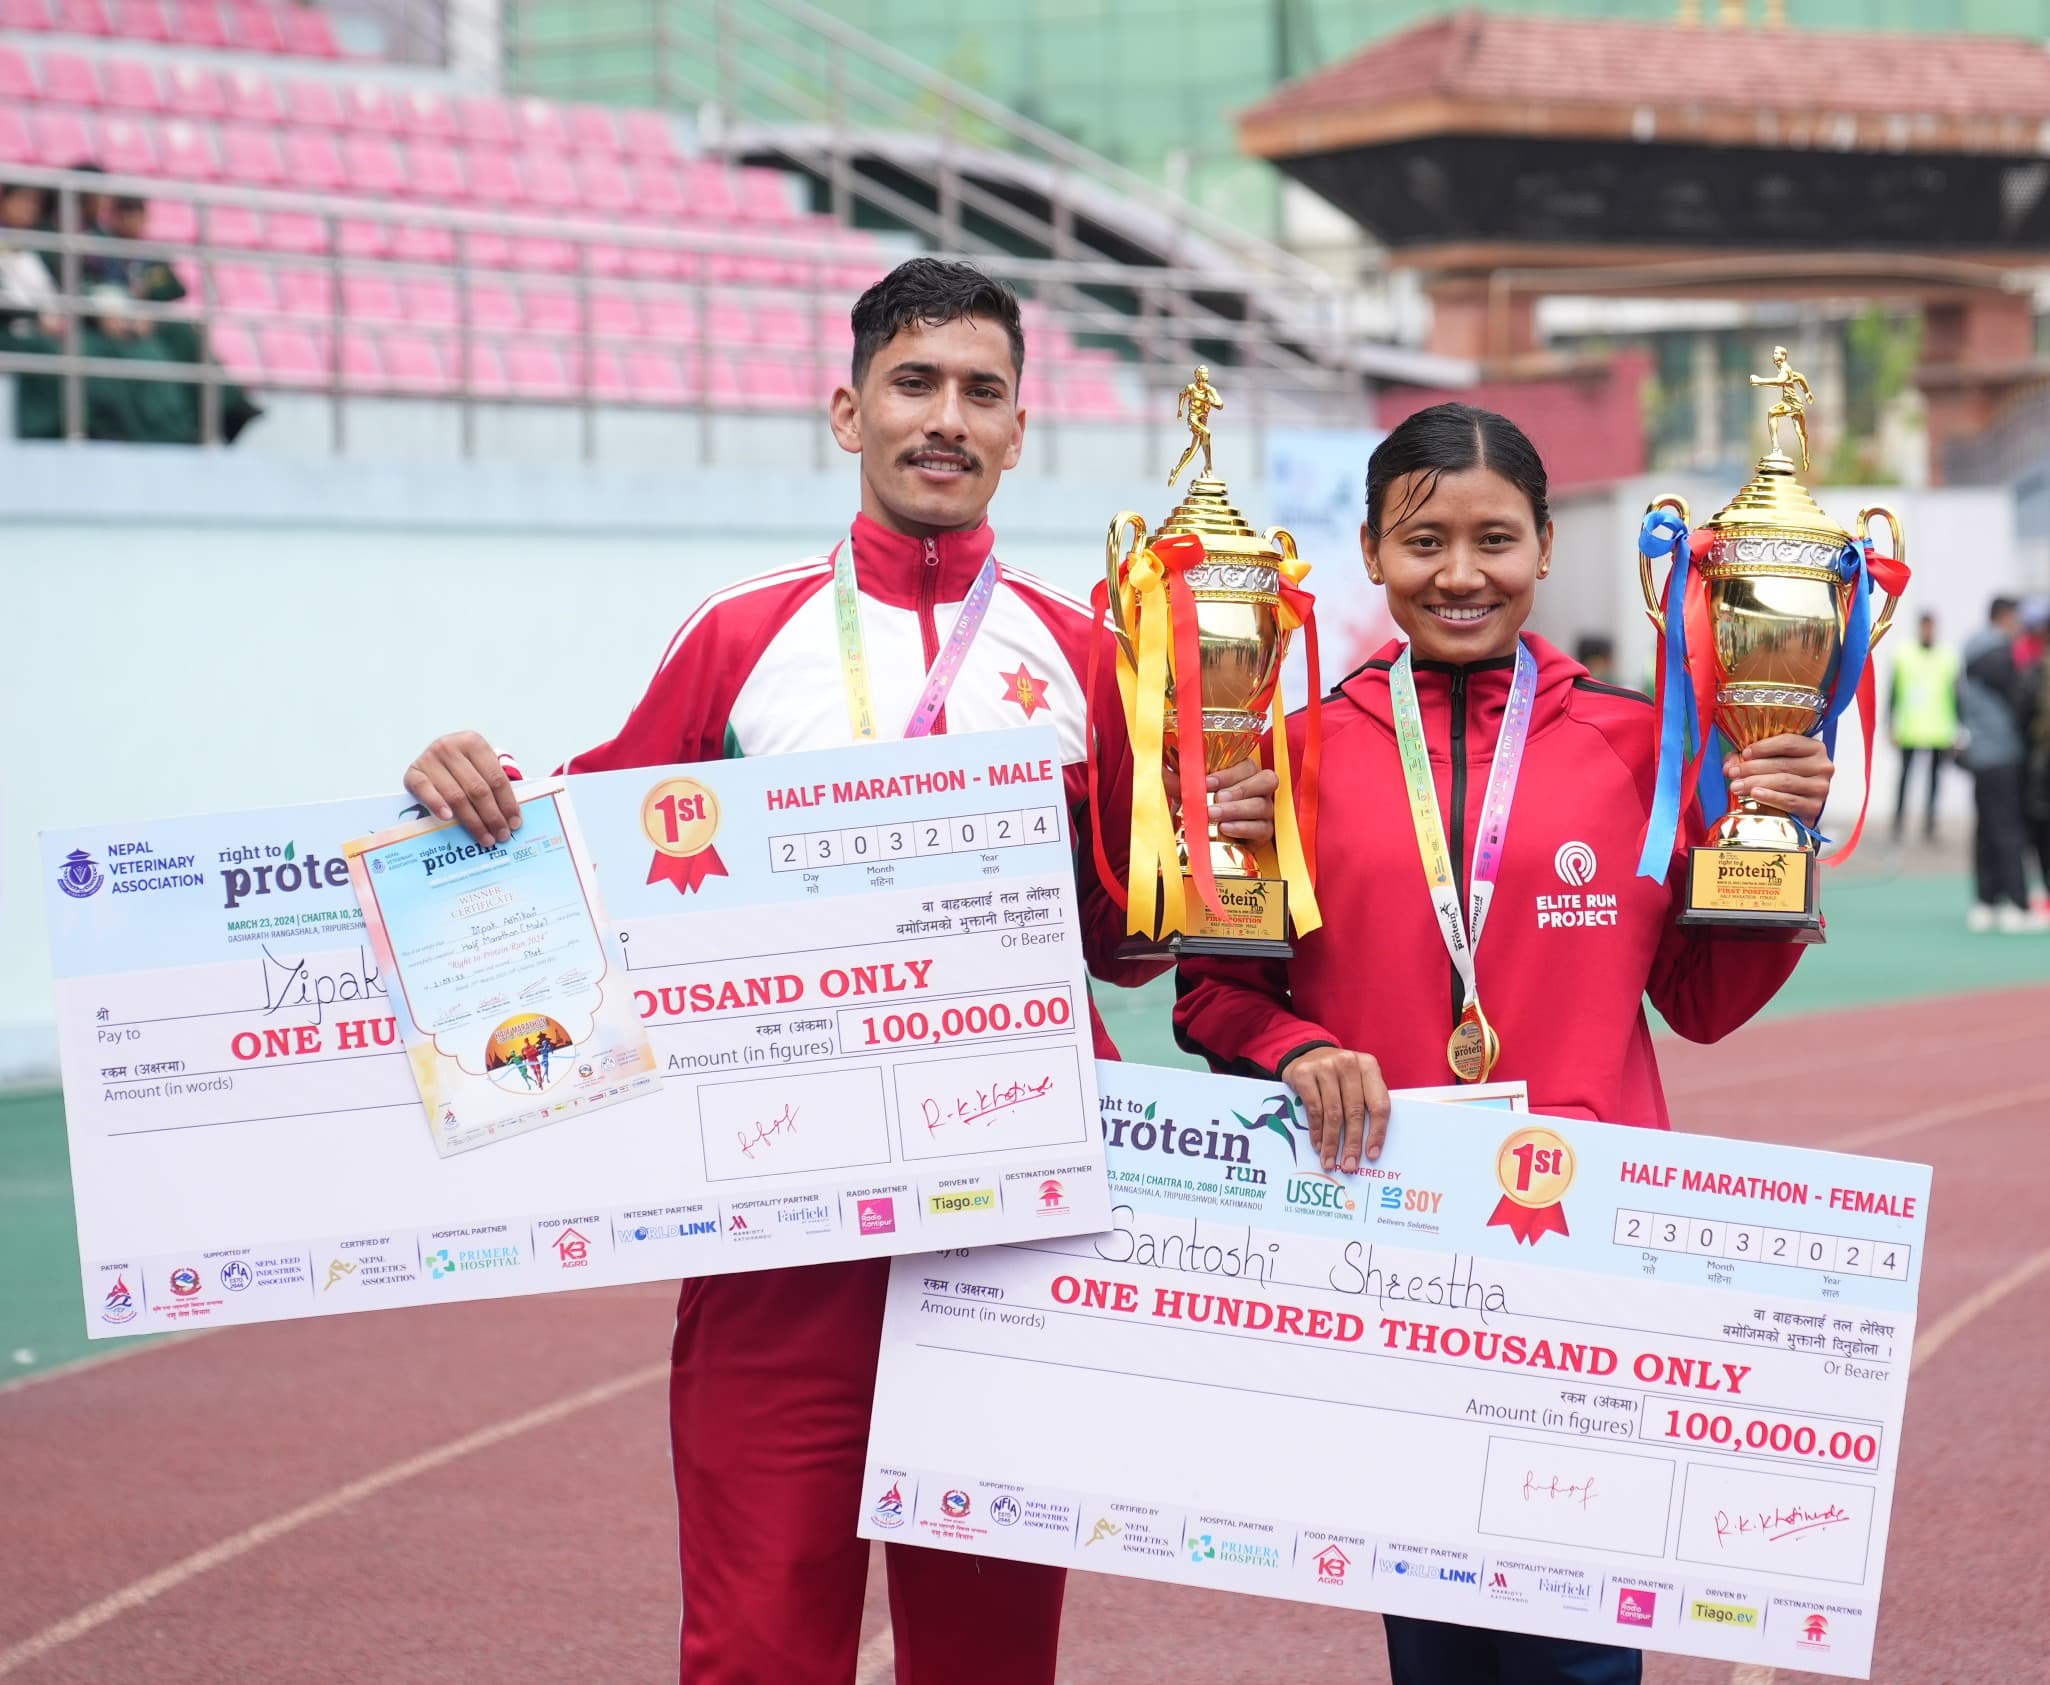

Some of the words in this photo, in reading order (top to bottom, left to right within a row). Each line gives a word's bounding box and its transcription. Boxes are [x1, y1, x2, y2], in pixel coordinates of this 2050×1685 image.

[766, 785, 826, 812] HALF
[832, 768, 966, 804] MARATHON
[988, 760, 1054, 786] MALE
[654, 794, 706, 844] 1st
[108, 841, 154, 857] NEPAL
[218, 846, 259, 865] right
[265, 844, 282, 858] to
[420, 847, 438, 858] right
[438, 844, 446, 852] to
[489, 848, 508, 860] run
[109, 855, 196, 876] VETERINARY
[803, 873, 820, 884] Day
[867, 864, 894, 876] Month
[980, 852, 999, 864] Year
[1718, 864, 1776, 880] protein
[111, 873, 204, 894] ASSOCIATION
[221, 852, 349, 910] prote
[459, 886, 502, 905] WINNER
[1218, 892, 1258, 906] otein
[1742, 888, 1780, 896] POSITION
[1536, 895, 1582, 910] ELITE
[1586, 894, 1617, 908] RUN
[228, 920, 258, 931] MARCH
[260, 918, 272, 928] 23,
[274, 914, 296, 926] 2024
[302, 910, 338, 924] CHAITRA
[340, 910, 351, 920] 10,
[352, 908, 364, 918] 20
[1538, 910, 1618, 928] PROJECT
[1001, 934, 1017, 948] Or
[1022, 930, 1065, 946] Bearer
[634, 974, 804, 1019] OUSAND
[819, 959, 934, 998] ONLY
[98, 1029, 122, 1044] Pay
[126, 1027, 140, 1042] to
[231, 1024, 322, 1061] ONE
[668, 1050, 738, 1072] Amount
[744, 1046, 765, 1064] (in
[770, 1038, 834, 1063] figures)
[862, 998, 1070, 1046] 100,000.00
[1455, 1044, 1482, 1060] protei
[101, 1066, 127, 1080] रकम
[135, 1060, 186, 1076] (अक्षरमा)
[104, 1086, 160, 1102] Amount
[164, 1082, 182, 1098] (in
[186, 1076, 234, 1094] words)
[1101, 1117, 1251, 1164] rotein
[1005, 1169, 1055, 1181] DESTINATION
[1056, 1165, 1092, 1176] PARTNER
[1226, 1164, 1266, 1184] run
[1512, 1143, 1563, 1192] 1st
[846, 1190, 871, 1198] RADIO
[872, 1185, 908, 1195] PARTNER
[938, 1180, 967, 1188] DRIVEN
[970, 1177, 980, 1185] BY
[1120, 1172, 1140, 1182] 2024
[1146, 1175, 1182, 1188] CHAITRA
[1184, 1180, 1195, 1191] 10,
[1197, 1182, 1218, 1193] 2080
[1224, 1186, 1266, 1199] SATURDAY
[1620, 1161, 1678, 1190] HALF
[1682, 1168, 1808, 1205] MARATHON
[1829, 1188, 1916, 1219] FEMALE
[732, 1198, 782, 1210] HOSPITALITY
[784, 1194, 820, 1204] PARTNER
[932, 1194, 990, 1212] Tiago.ev
[1114, 1184, 1162, 1198] RANGASHALA,
[1164, 1190, 1218, 1204] TRIPURESHWOR,
[1220, 1199, 1263, 1211] KATHMANDU
[1286, 1179, 1346, 1210] USSEC
[1380, 1186, 1402, 1210] US
[1404, 1188, 1442, 1214] SOY
[624, 1208, 663, 1220] INTERNET
[666, 1204, 703, 1214] PARTNER
[776, 1206, 830, 1224] Fairfield
[538, 1220, 560, 1228] FOOD
[562, 1215, 600, 1226] PARTNER
[1377, 1216, 1406, 1227] Delivers
[1408, 1220, 1440, 1232] Solutions
[432, 1229, 470, 1240] HOSPITAL
[472, 1224, 507, 1235] PARTNER
[618, 1220, 717, 1243] WORLDLINK
[459, 1246, 519, 1261] PRIMERA
[1094, 1206, 1279, 1288] Santoshi
[100, 1263, 128, 1272] PATRON
[360, 1256, 385, 1264] NEPAL
[460, 1258, 520, 1272] HOSPITAL
[562, 1260, 588, 1270] AGRO
[1642, 1252, 1658, 1264] Day
[1706, 1260, 1735, 1273] Month
[1823, 1275, 1841, 1286] Year
[222, 1262, 249, 1280] NFIA
[360, 1264, 407, 1276] ATHLETICS
[361, 1274, 416, 1287] ASSOCIATION
[923, 1278, 949, 1292] रकम
[955, 1282, 1004, 1300] (अक्षरमा)
[920, 1299, 976, 1320] Amount
[979, 1306, 998, 1324] (in
[1001, 1312, 1046, 1330] words)
[1050, 1274, 1140, 1313] ONE
[1151, 1288, 1365, 1343] HUNDRED
[1378, 1318, 1618, 1377] THOUSAND
[1633, 1351, 1752, 1395] ONLY
[1824, 1360, 1840, 1374] Or
[1844, 1364, 1890, 1382] Bearer
[1466, 1398, 1538, 1424] Amount
[1542, 1407, 1566, 1428] (in
[1568, 1409, 1634, 1438] figures)
[1664, 1409, 1878, 1464] 100,000.00
[880, 1468, 907, 1478] PATRON
[993, 1497, 1016, 1514] NFIA
[1110, 1504, 1148, 1516] CERTIFIED
[1200, 1516, 1236, 1527] HOSPITAL
[1238, 1520, 1274, 1532] PARTNER
[1122, 1534, 1169, 1546] ATHLETICS
[1304, 1530, 1326, 1540] FOOD
[1328, 1534, 1366, 1546] PARTNER
[1122, 1545, 1176, 1559] ASSOCIATION
[1221, 1541, 1280, 1558] PRIMERA
[1388, 1544, 1428, 1556] INTERNET
[1430, 1548, 1468, 1560] PARTNER
[1220, 1552, 1279, 1568] HOSPITAL
[1496, 1560, 1548, 1573] HOSPITALITY
[1548, 1566, 1584, 1578] PARTNER
[1379, 1558, 1478, 1585] WORLDLINK
[1318, 1577, 1344, 1586] AGRO
[1538, 1578, 1592, 1598] Fairfield
[1612, 1576, 1636, 1586] RADIO
[1638, 1579, 1674, 1590] PARTNER
[1705, 1588, 1734, 1599] DRIVEN
[1736, 1592, 1747, 1601] BY
[1695, 1604, 1754, 1624] Tiago.ev
[1773, 1598, 1824, 1612] DESTINATION
[1826, 1604, 1862, 1616] PARTNER
